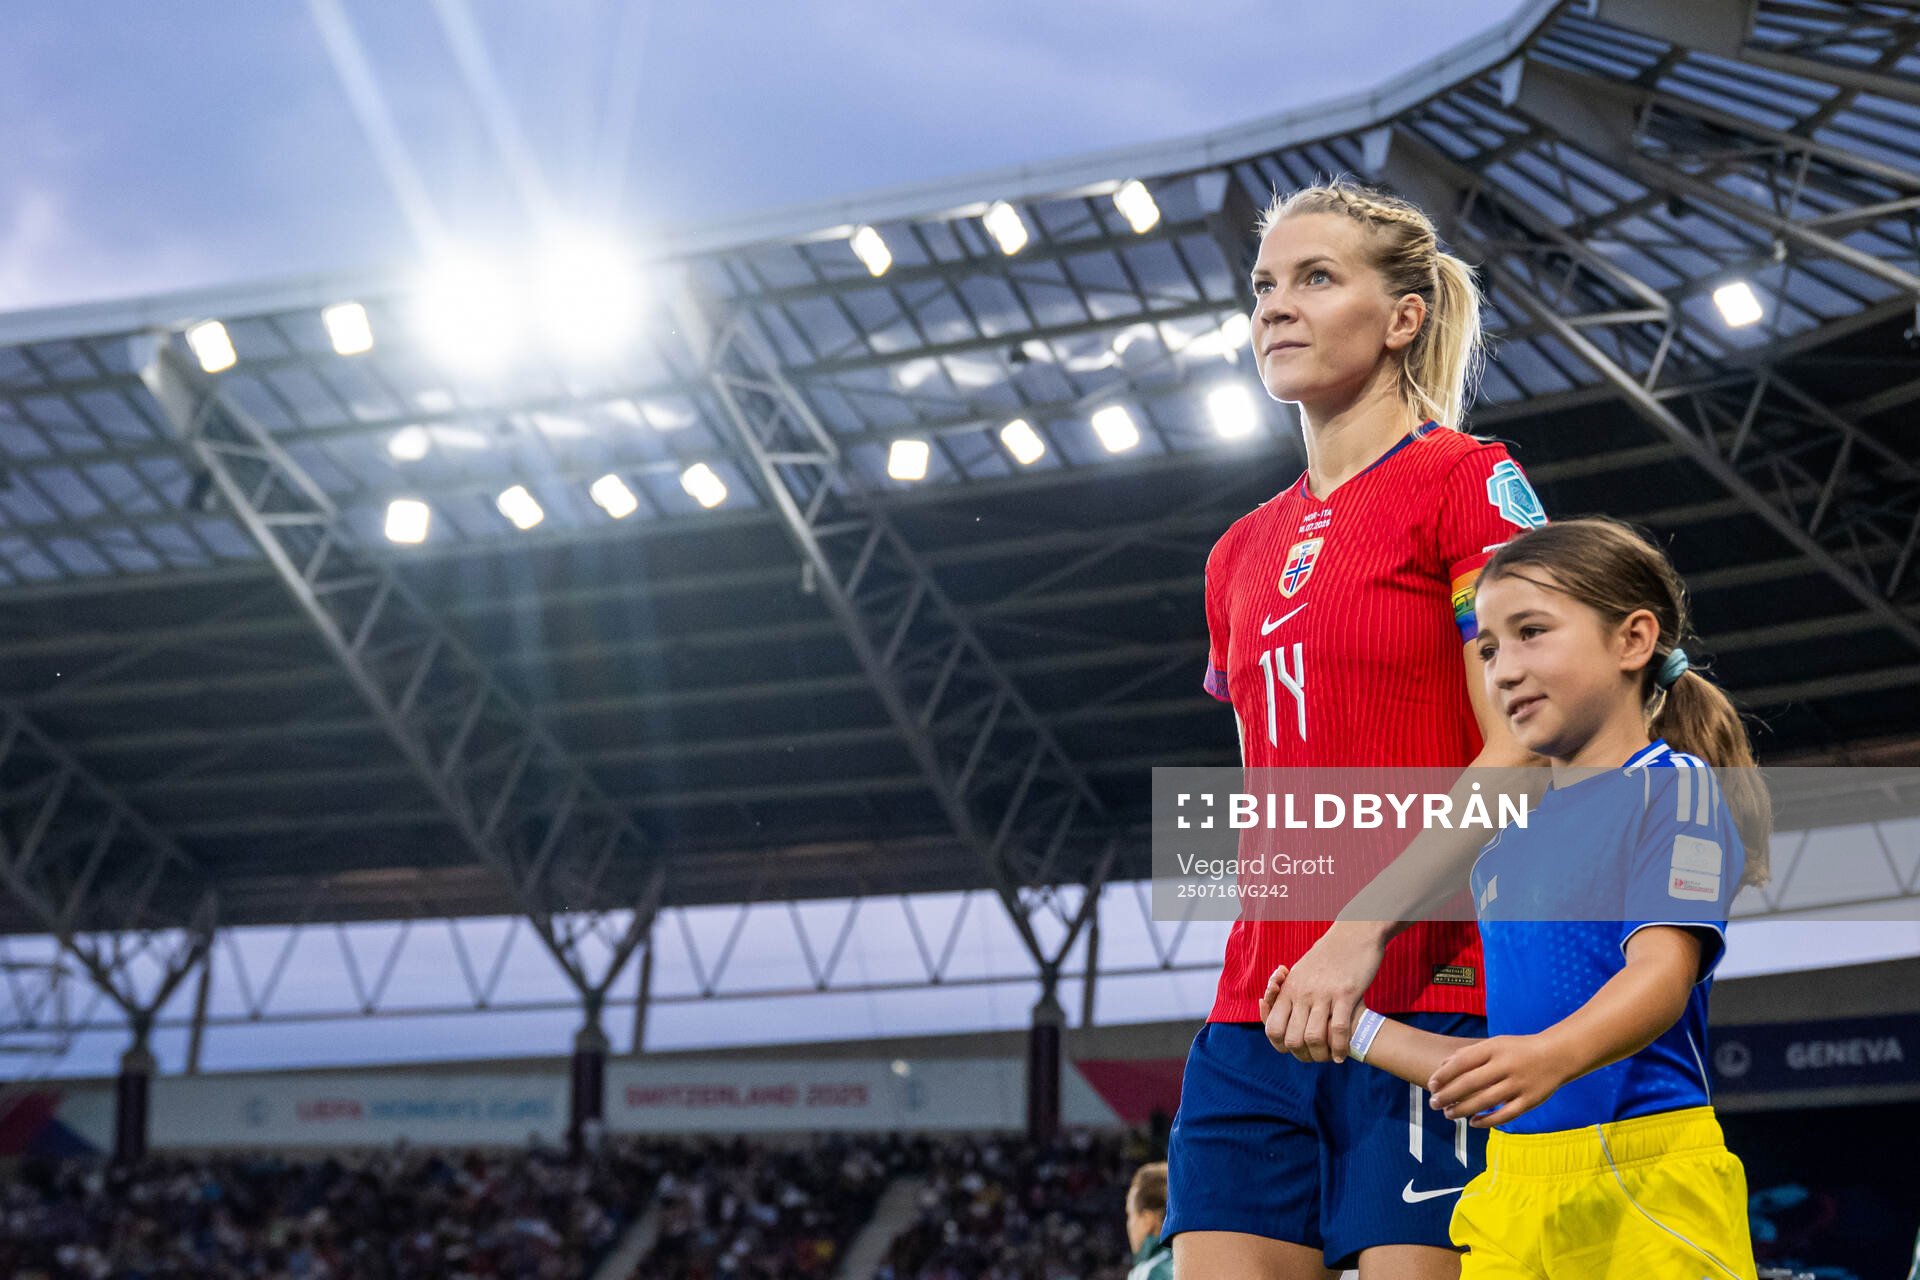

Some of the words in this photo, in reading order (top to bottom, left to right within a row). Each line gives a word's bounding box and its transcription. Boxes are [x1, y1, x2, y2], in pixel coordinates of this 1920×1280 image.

[1259, 642, 1307, 748] 14
[1786, 1037, 1904, 1069] GENEVA
[625, 1083, 798, 1108] SWITZERLAND
